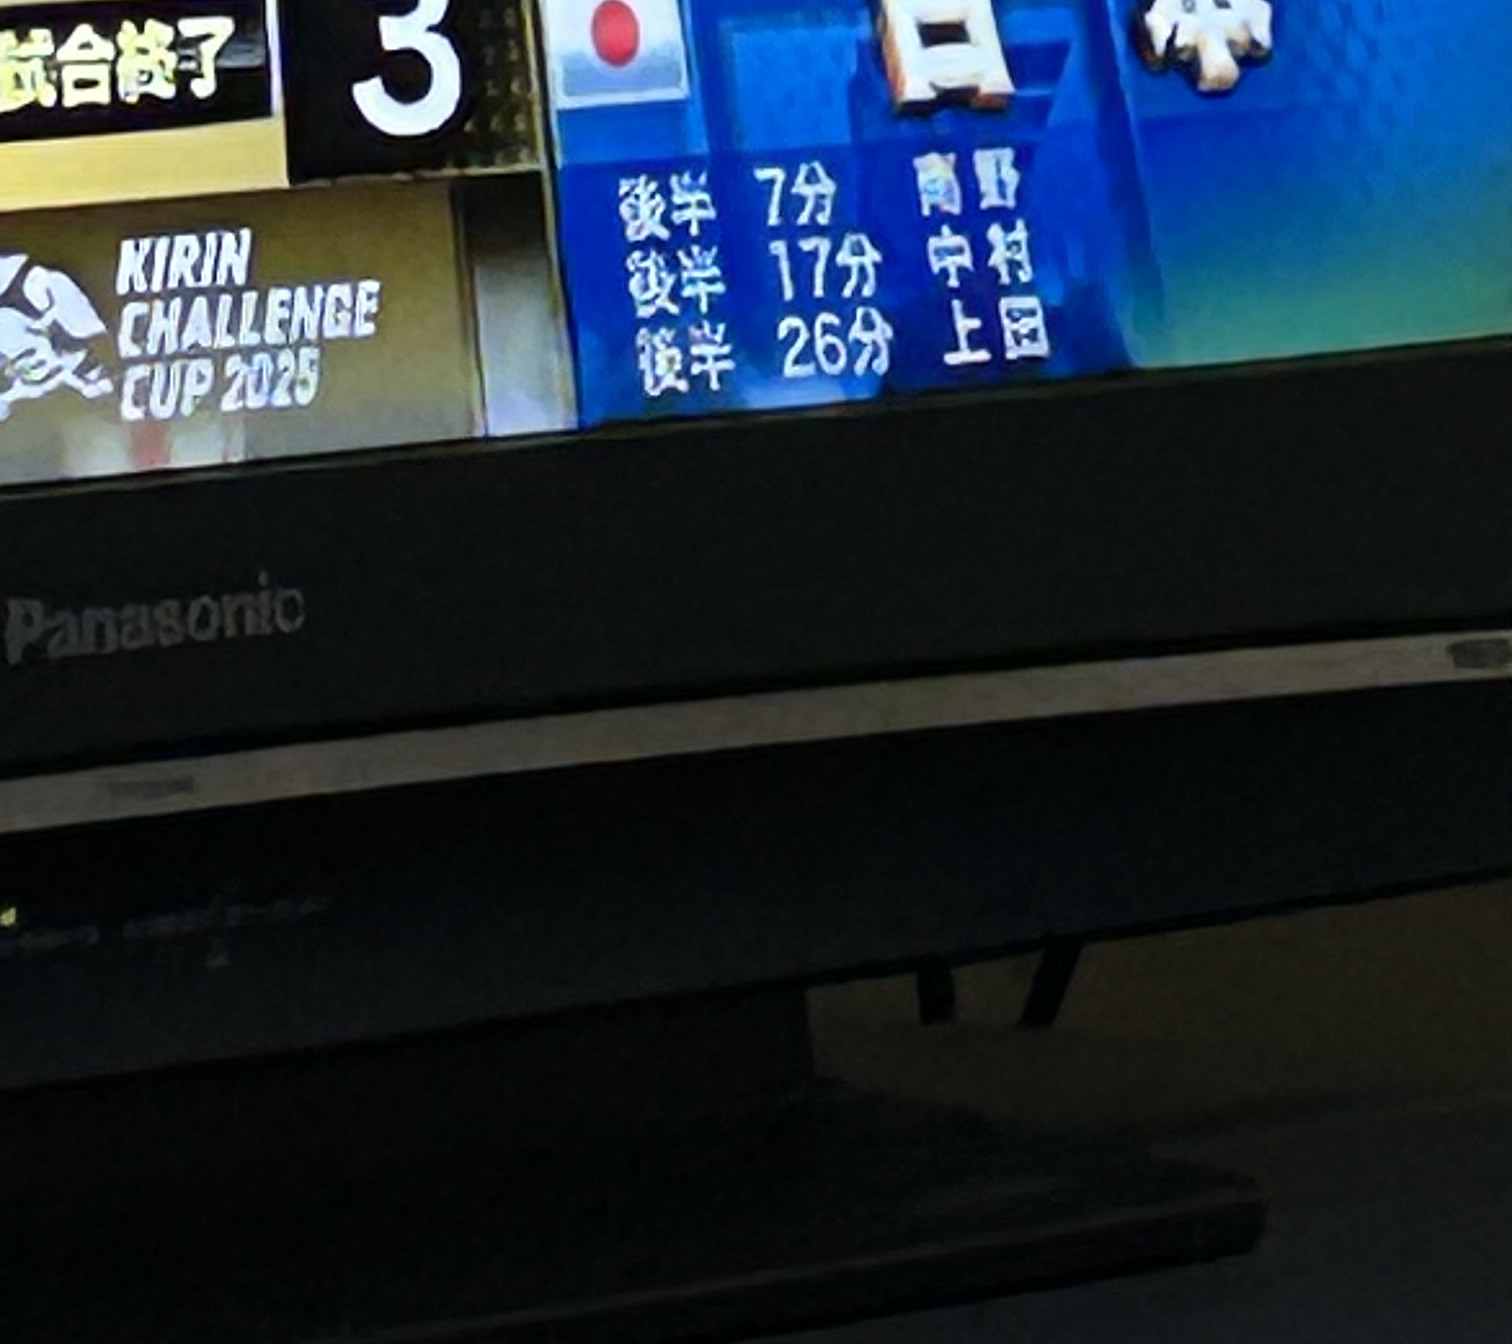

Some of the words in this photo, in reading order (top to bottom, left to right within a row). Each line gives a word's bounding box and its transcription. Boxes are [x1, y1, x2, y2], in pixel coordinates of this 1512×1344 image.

[618, 170, 717, 242] 後半
[753, 160, 837, 227] 7分
[115, 227, 252, 296] KIRIN
[626, 244, 726, 318] 後半
[769, 232, 883, 302] 17分
[925, 217, 1034, 289] 中村
[117, 279, 381, 359] CHALLENGE
[636, 319, 736, 397] 後半
[777, 306, 894, 379] 26分
[942, 295, 1051, 366] 上田
[120, 358, 215, 421] CUP
[220, 346, 321, 412] 2025
[4, 571, 307, 665] Panasonic
